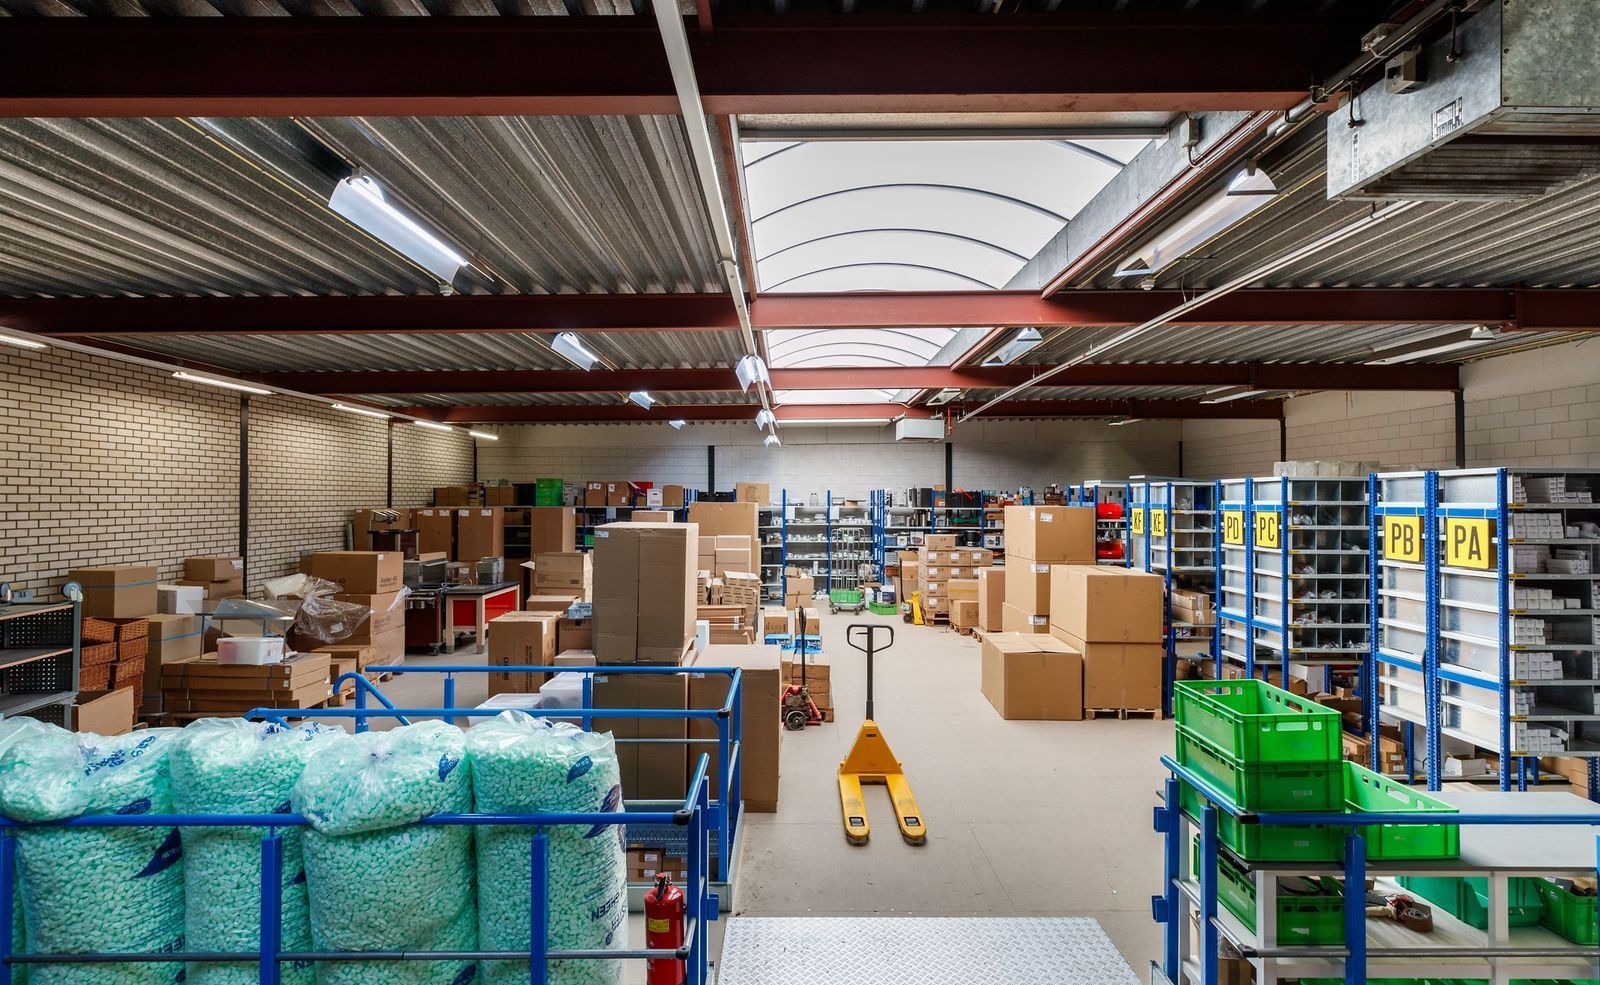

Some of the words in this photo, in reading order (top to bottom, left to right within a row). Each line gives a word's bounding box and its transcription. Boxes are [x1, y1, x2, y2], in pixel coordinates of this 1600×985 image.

[1134, 511, 1142, 530] KF
[1152, 513, 1161, 532] KE
[1227, 516, 1238, 540] PD
[1259, 516, 1275, 541] PC
[1391, 522, 1414, 556] PB
[1454, 524, 1482, 561] PA
